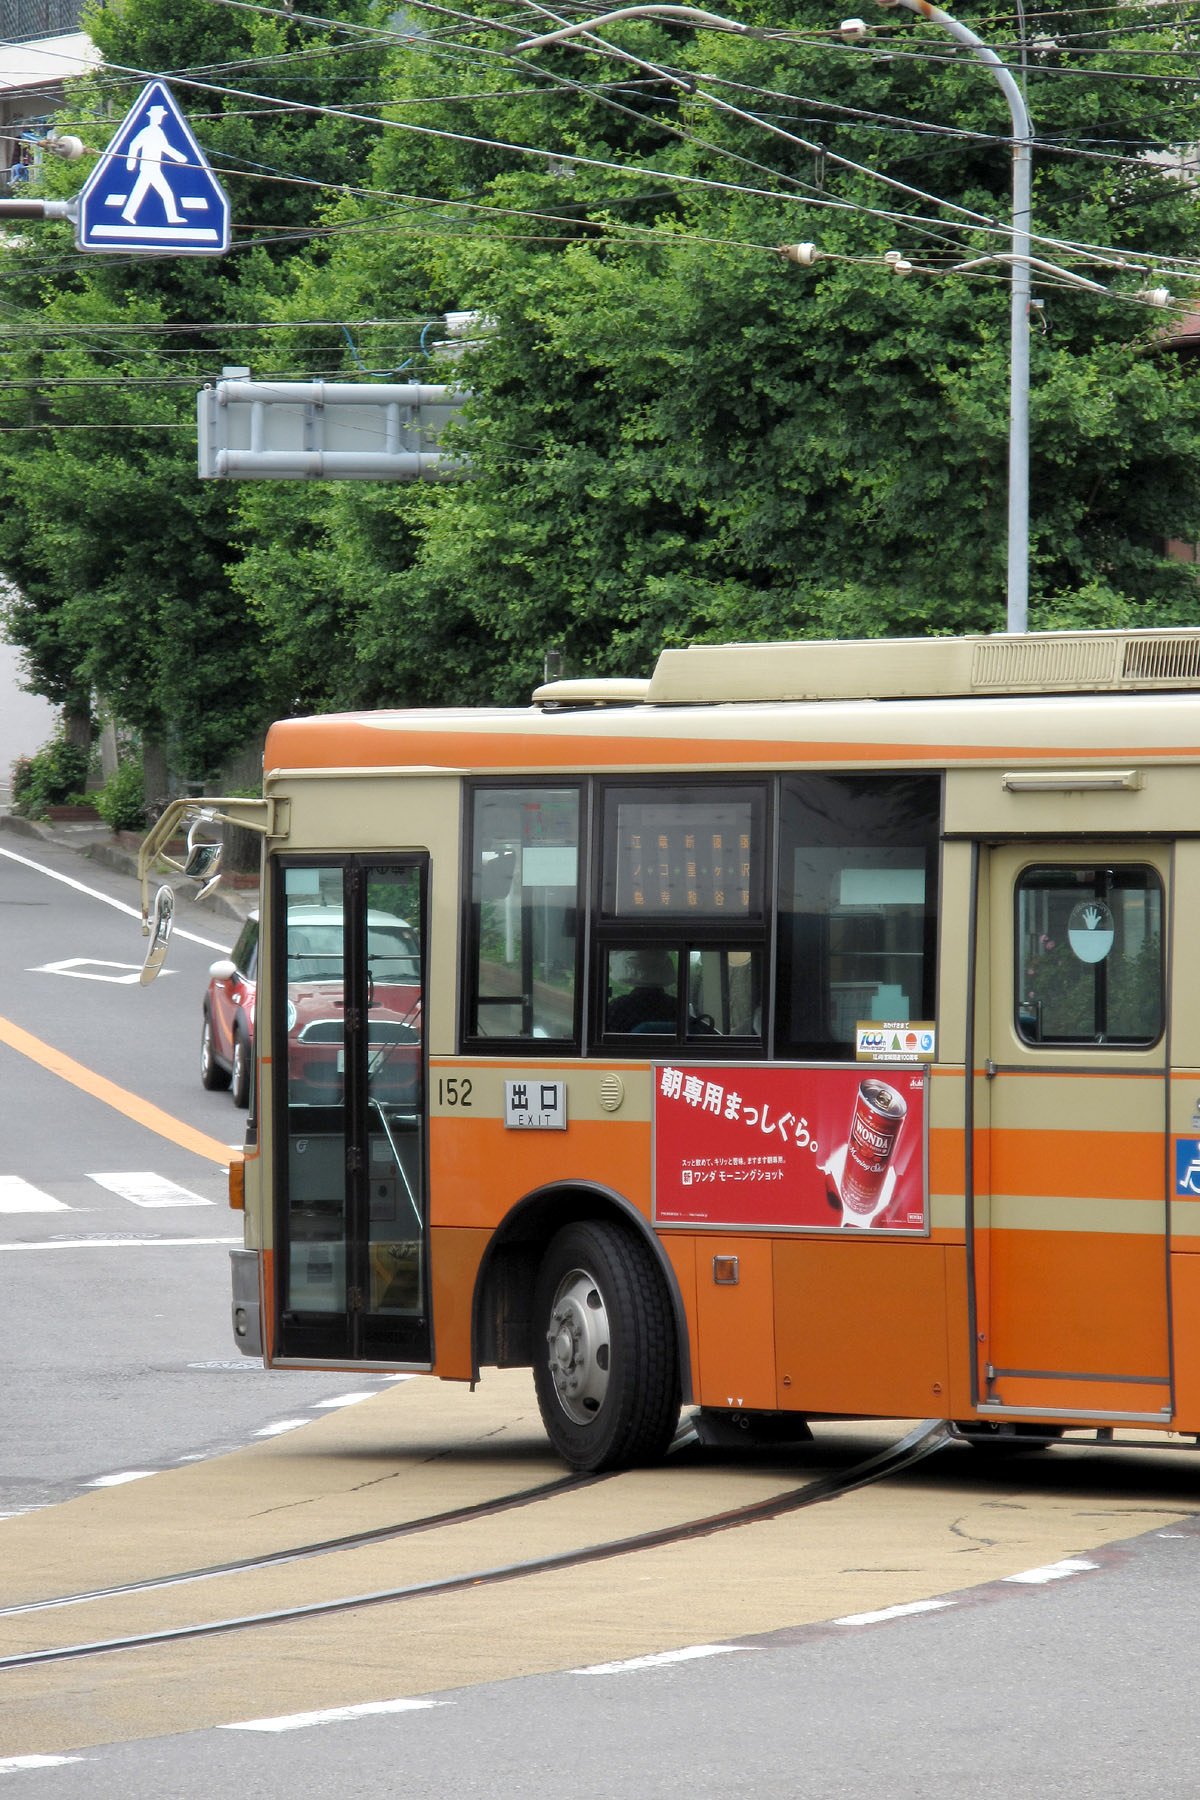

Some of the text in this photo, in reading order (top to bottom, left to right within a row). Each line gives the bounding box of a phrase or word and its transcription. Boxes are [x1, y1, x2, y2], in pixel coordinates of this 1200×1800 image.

[439, 1079, 472, 1106] 152
[511, 1084, 557, 1110] 出口
[518, 1114, 551, 1126] EXIT
[660, 1067, 819, 1153] 朝専用まっしぐら。
[856, 1119, 888, 1149] WONDA
[694, 1170, 717, 1183] ワンダ
[718, 1168, 784, 1182] モーニングショット
